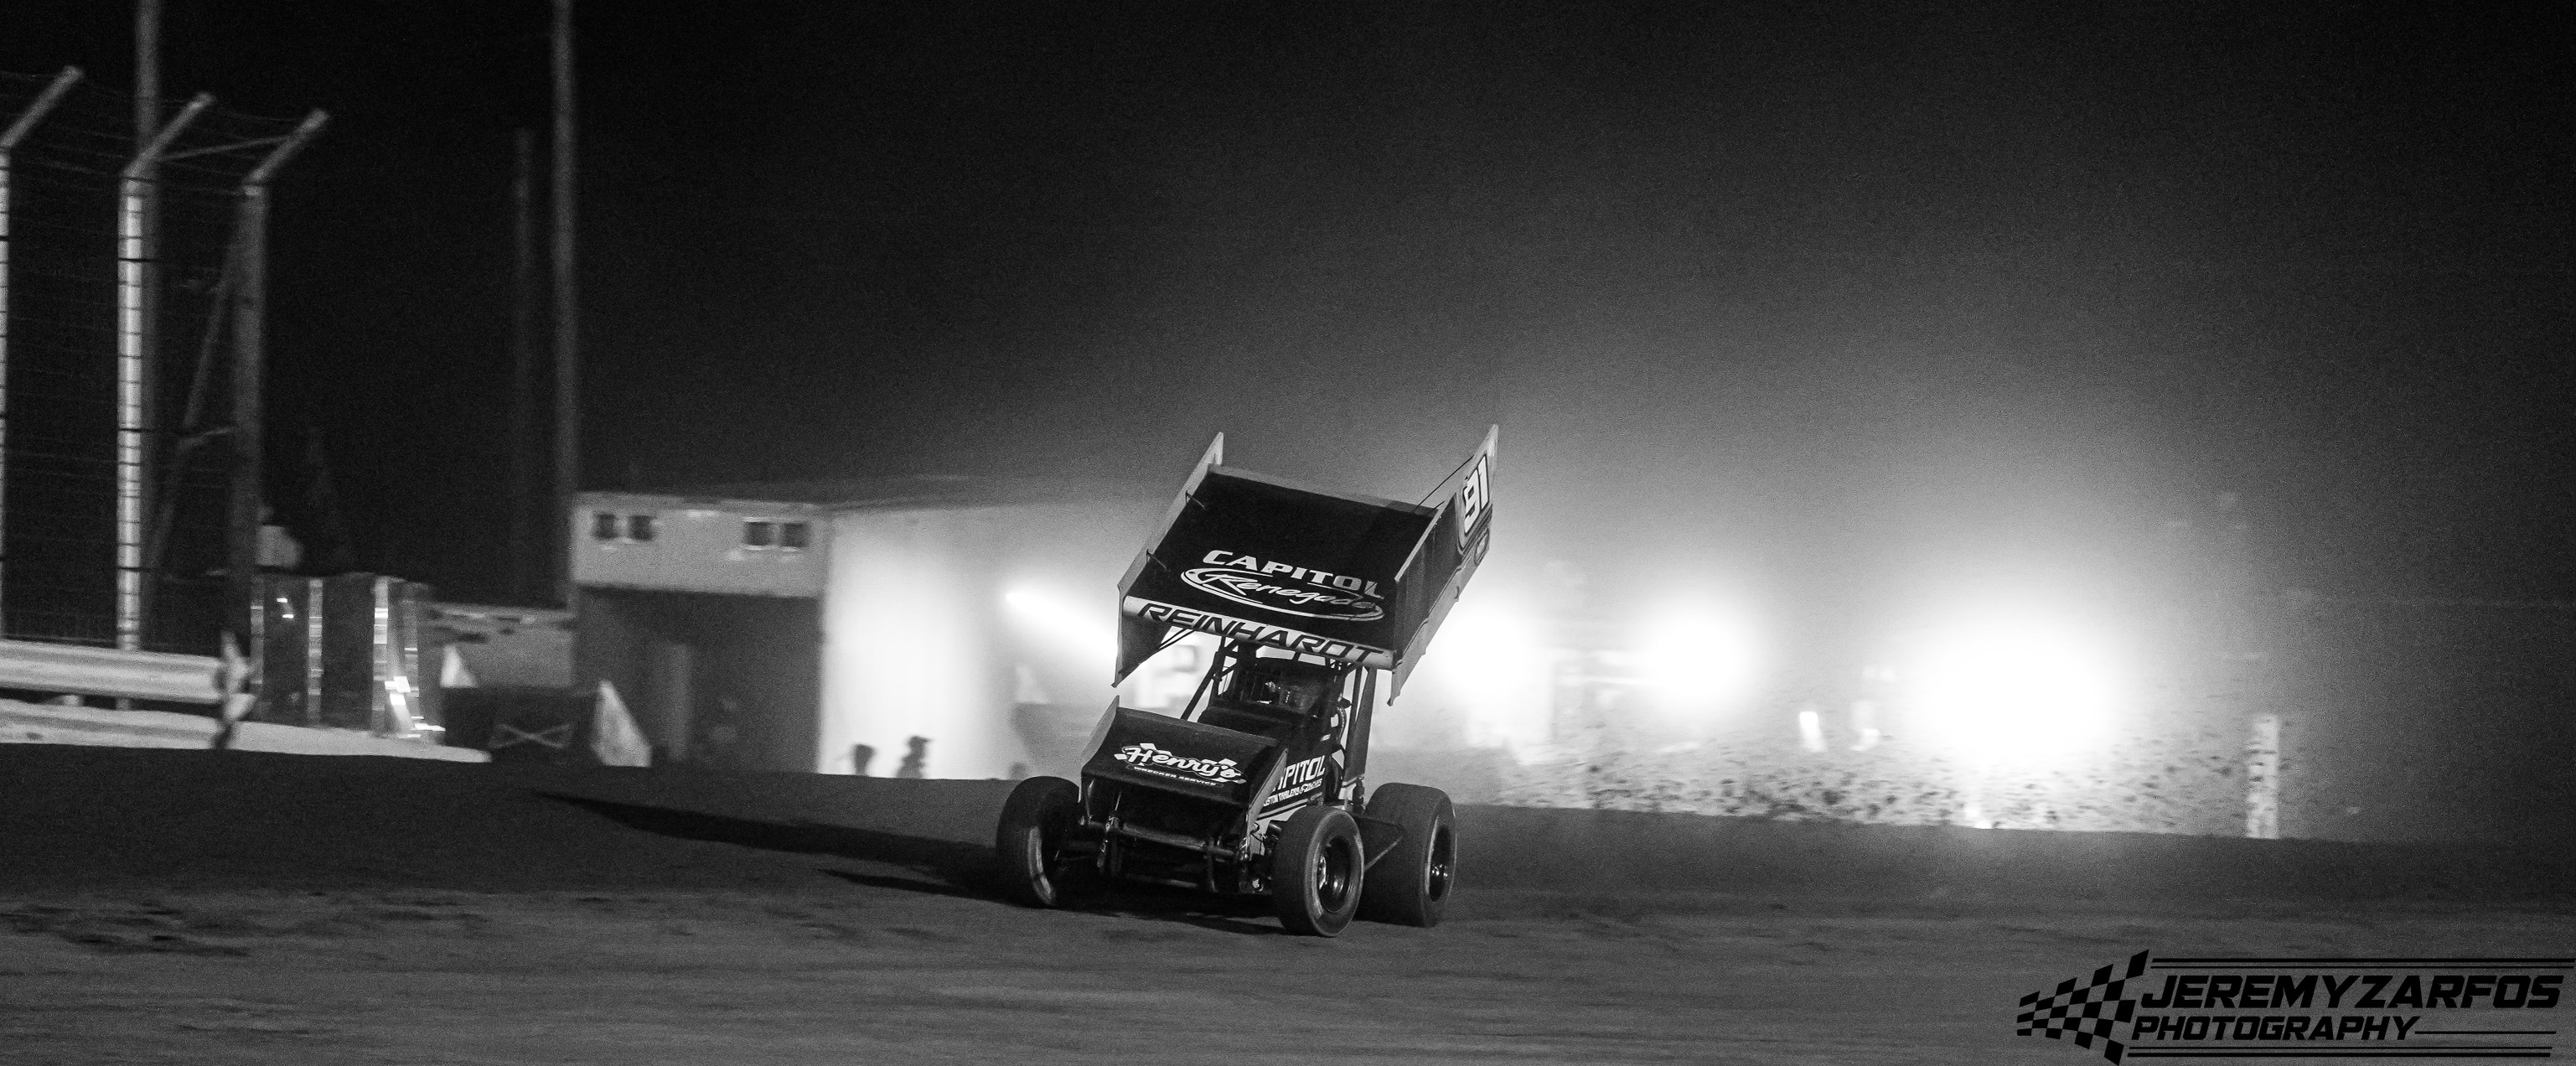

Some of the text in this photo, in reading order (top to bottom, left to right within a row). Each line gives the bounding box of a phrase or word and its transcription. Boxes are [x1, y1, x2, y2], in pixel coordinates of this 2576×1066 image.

[1463, 453, 1488, 533] 91
[1203, 550, 1384, 599] CAPITOL
[1204, 573, 1377, 608] Renegade
[1137, 603, 1382, 663] REINHARDT
[1124, 747, 1241, 777] Henry's
[1273, 755, 1326, 791] PITOL
